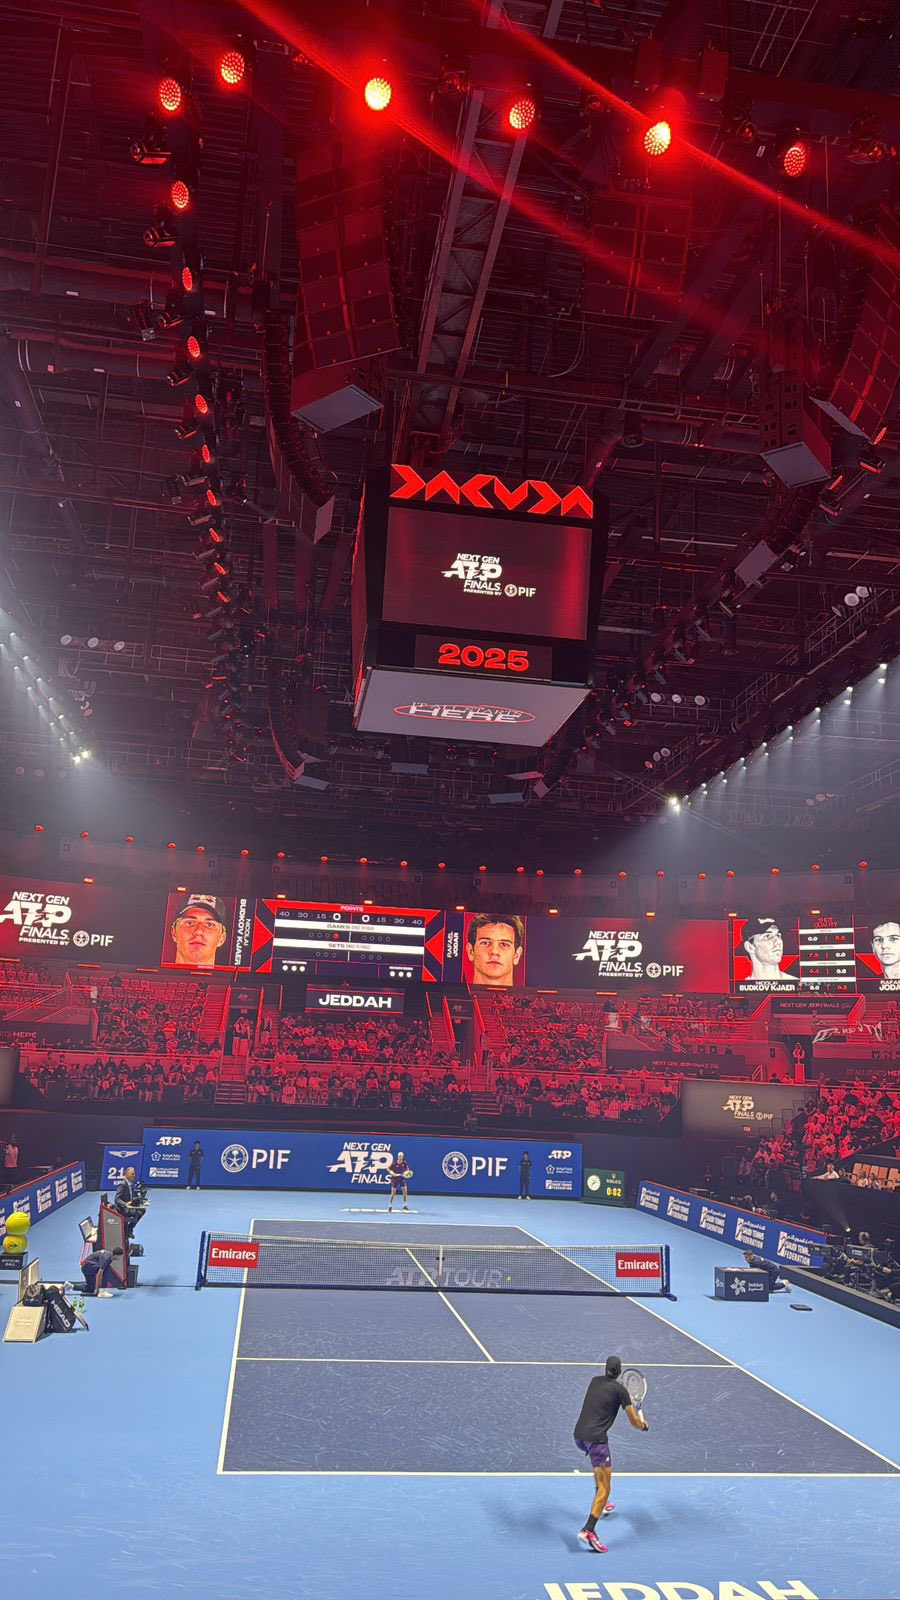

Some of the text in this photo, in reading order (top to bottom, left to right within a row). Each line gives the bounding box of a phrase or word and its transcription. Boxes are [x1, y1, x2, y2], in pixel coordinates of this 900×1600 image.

[456, 552, 500, 564] NEXT GEN
[441, 559, 502, 581] ATP
[518, 586, 537, 598] PIF
[438, 642, 529, 672] 2025
[408, 705, 519, 723] HERE
[12, 890, 70, 906] NEXT GEN
[0, 899, 72, 928] ATP
[340, 904, 364, 912] POINTS
[411, 918, 423, 926] 40
[234, 899, 247, 966] BUDKOV KJAER
[589, 930, 639, 940] NEXT GEN
[18, 936, 59, 946] PRESENTED
[90, 933, 114, 947] PIF
[571, 938, 643, 962] ATP
[662, 965, 684, 977] PIF
[318, 993, 393, 1009] JEDDAH
[721, 1099, 755, 1111] ATP
[155, 1136, 182, 1146] ATP
[343, 1141, 392, 1152] NEXT GEN
[252, 1149, 291, 1169] PIF
[548, 1149, 572, 1160] ATP
[326, 1150, 394, 1174] ATP
[471, 1156, 509, 1177] PIF
[351, 1173, 392, 1185] FINALS
[211, 1247, 256, 1260] Emirates
[784, 1249, 811, 1266] FEDERATION
[618, 1259, 659, 1270] Emirates
[439, 1267, 502, 1288] TOUR
[50, 1300, 70, 1328] HEAD
